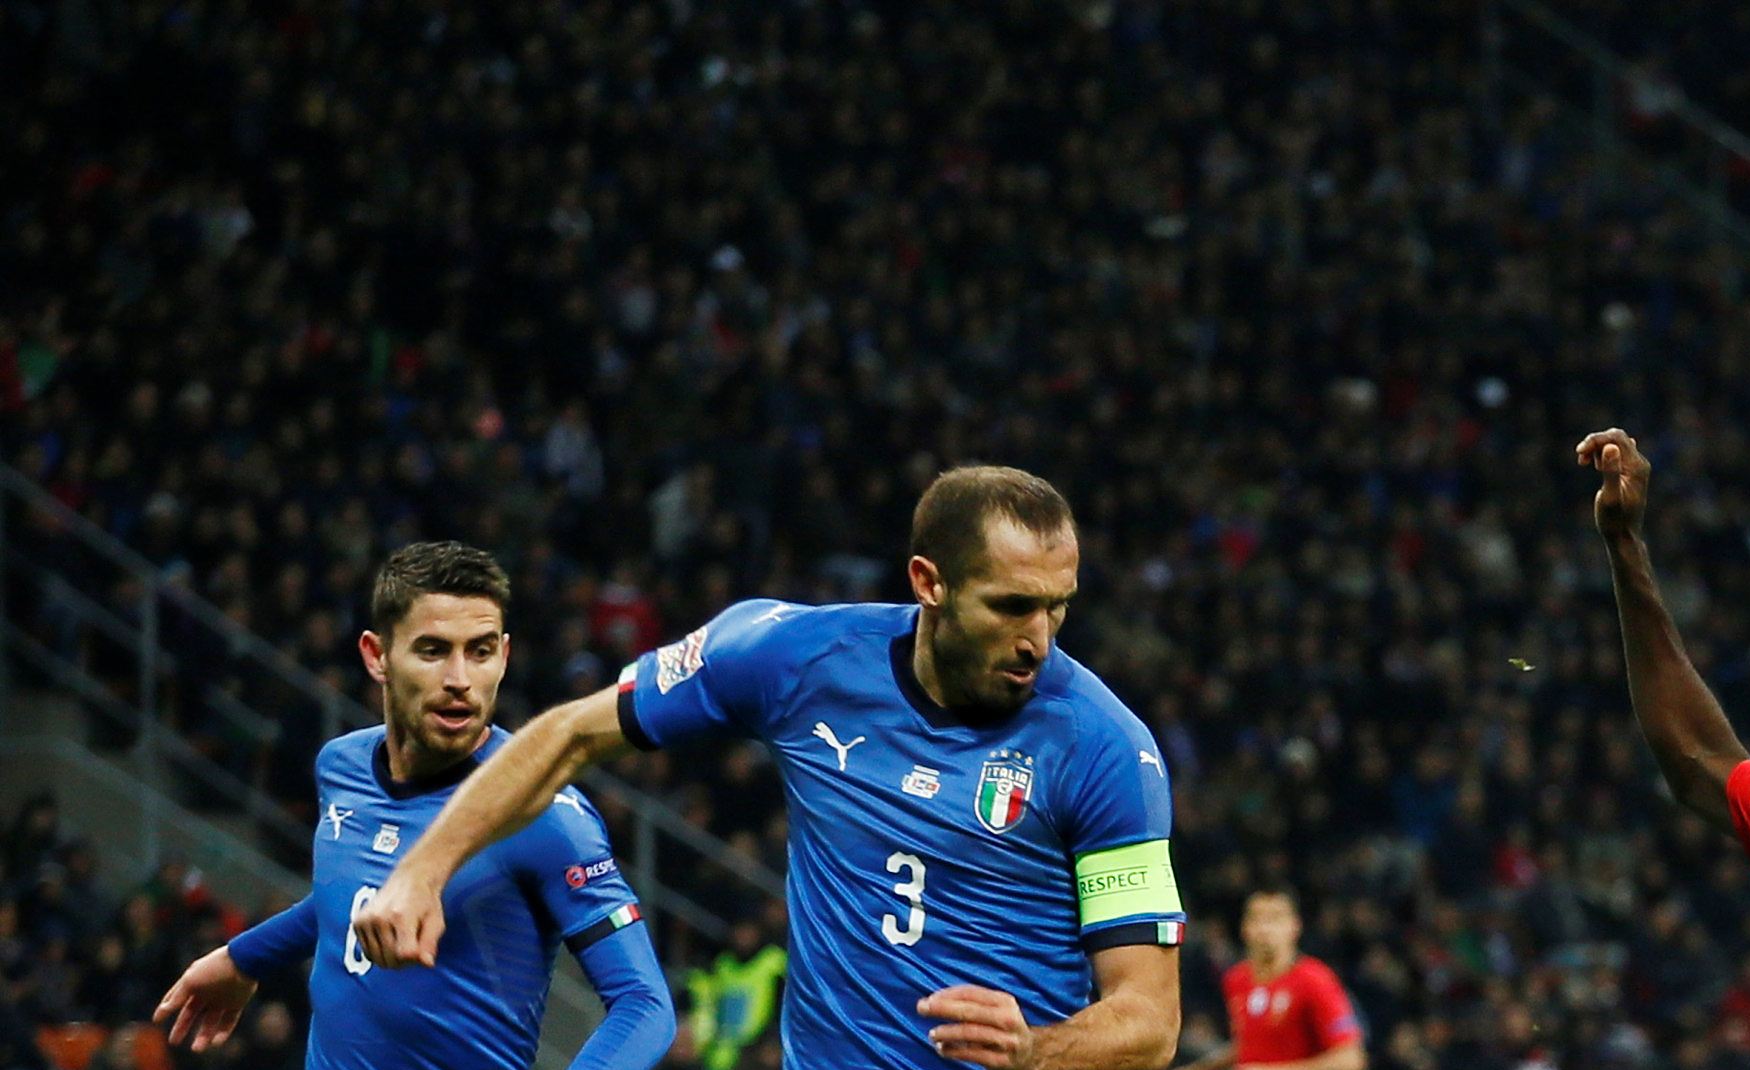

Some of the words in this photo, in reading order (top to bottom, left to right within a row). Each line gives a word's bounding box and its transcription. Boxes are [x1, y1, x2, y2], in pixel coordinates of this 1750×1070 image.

[986, 766, 1028, 785] ITALIA
[1080, 871, 1148, 895] RESPECT
[882, 851, 926, 946] 3
